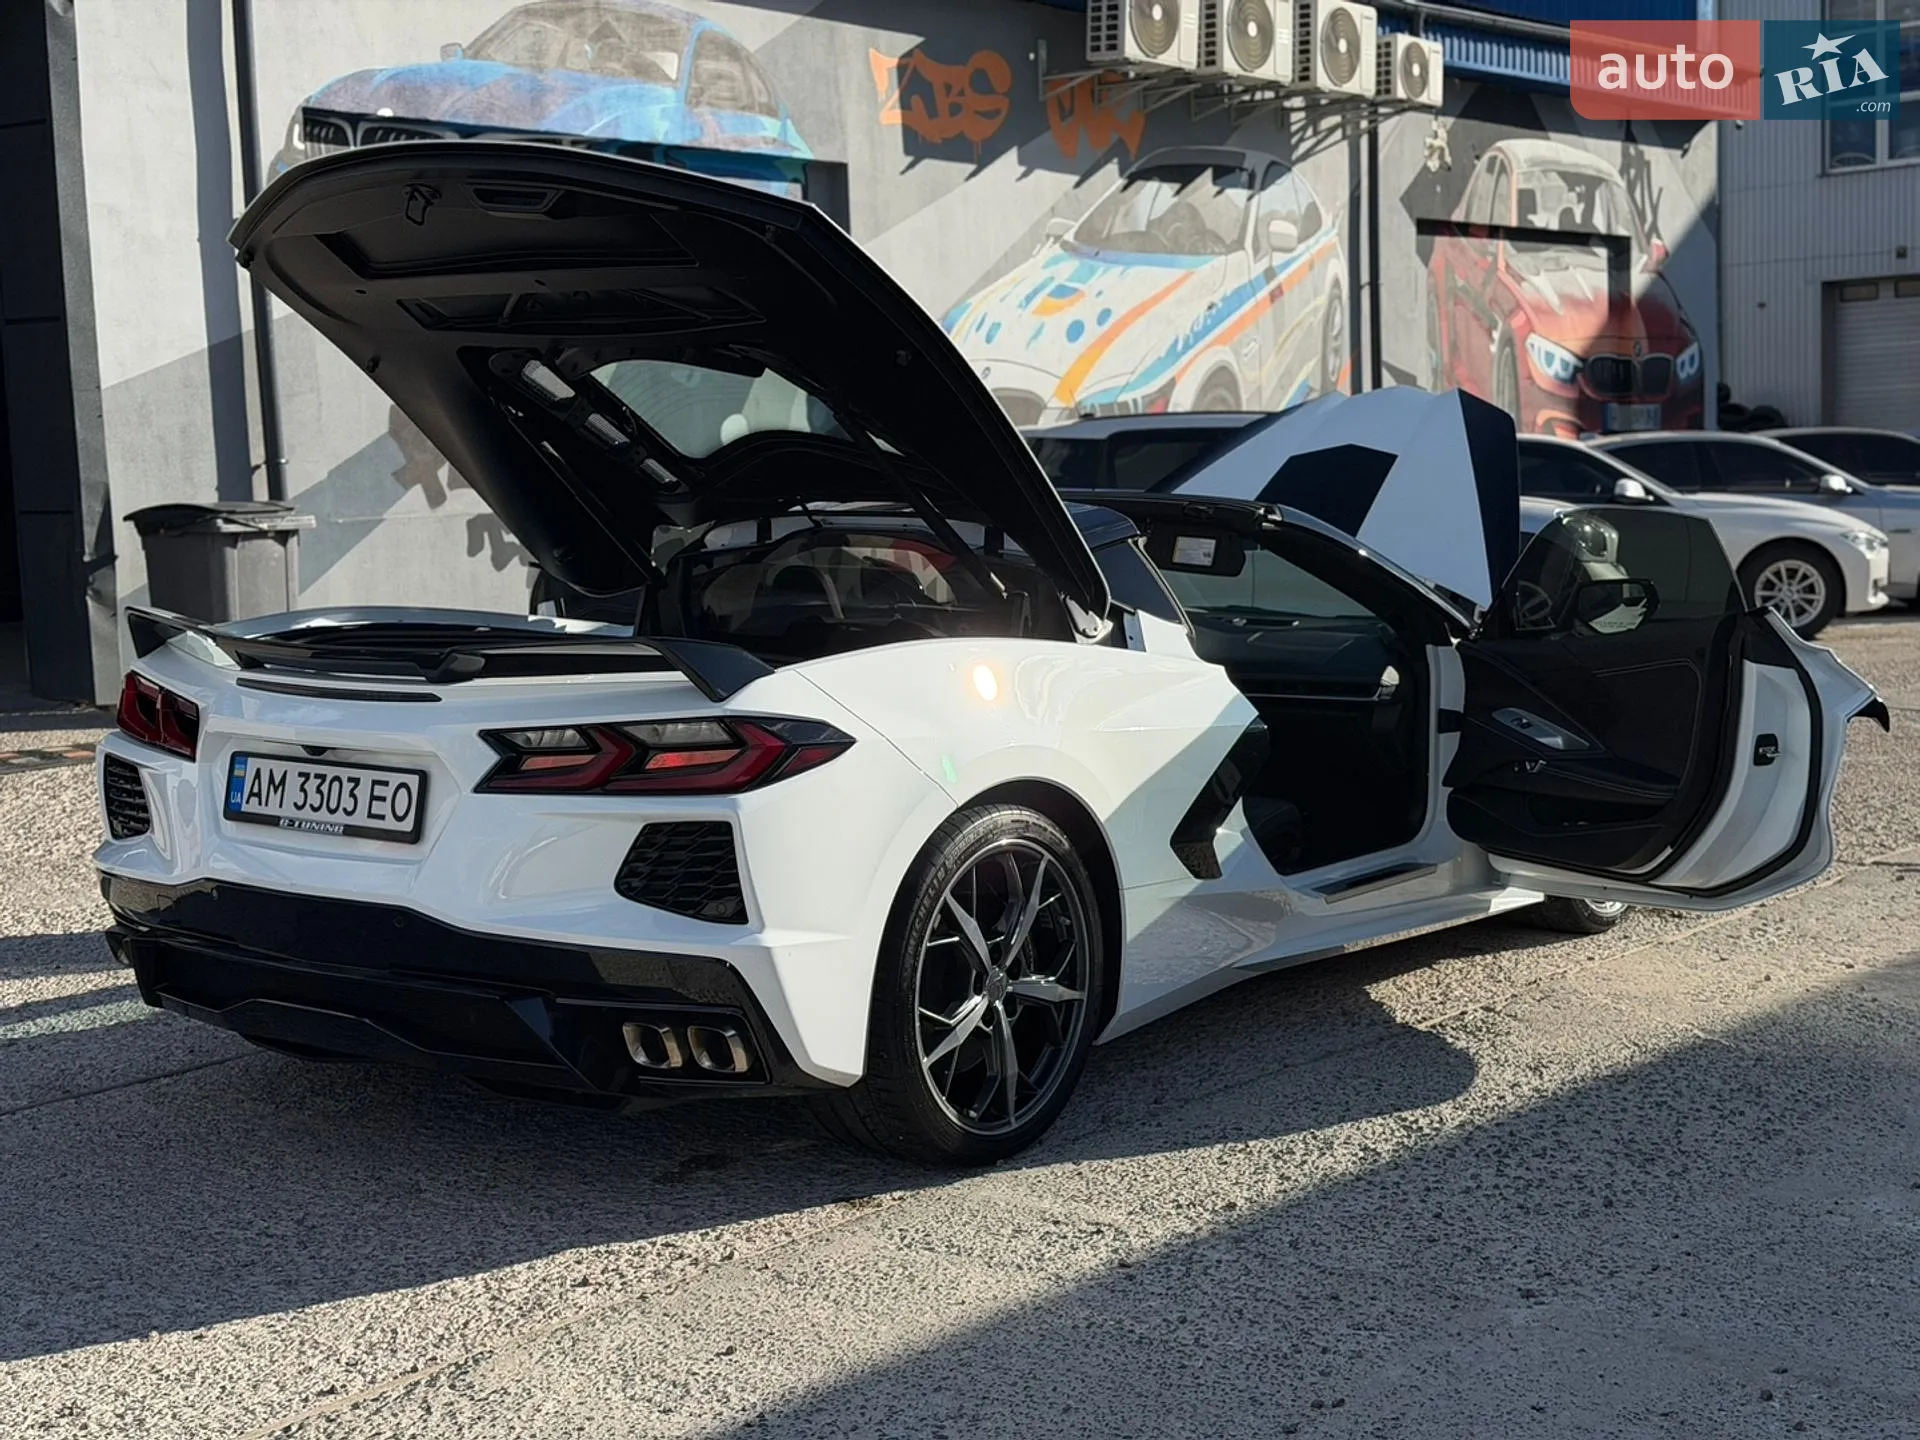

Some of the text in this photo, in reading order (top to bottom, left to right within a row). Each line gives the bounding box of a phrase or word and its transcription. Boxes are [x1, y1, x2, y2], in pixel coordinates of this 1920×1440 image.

[230, 791, 241, 804] UA
[245, 767, 413, 822] AM 3303 EO
